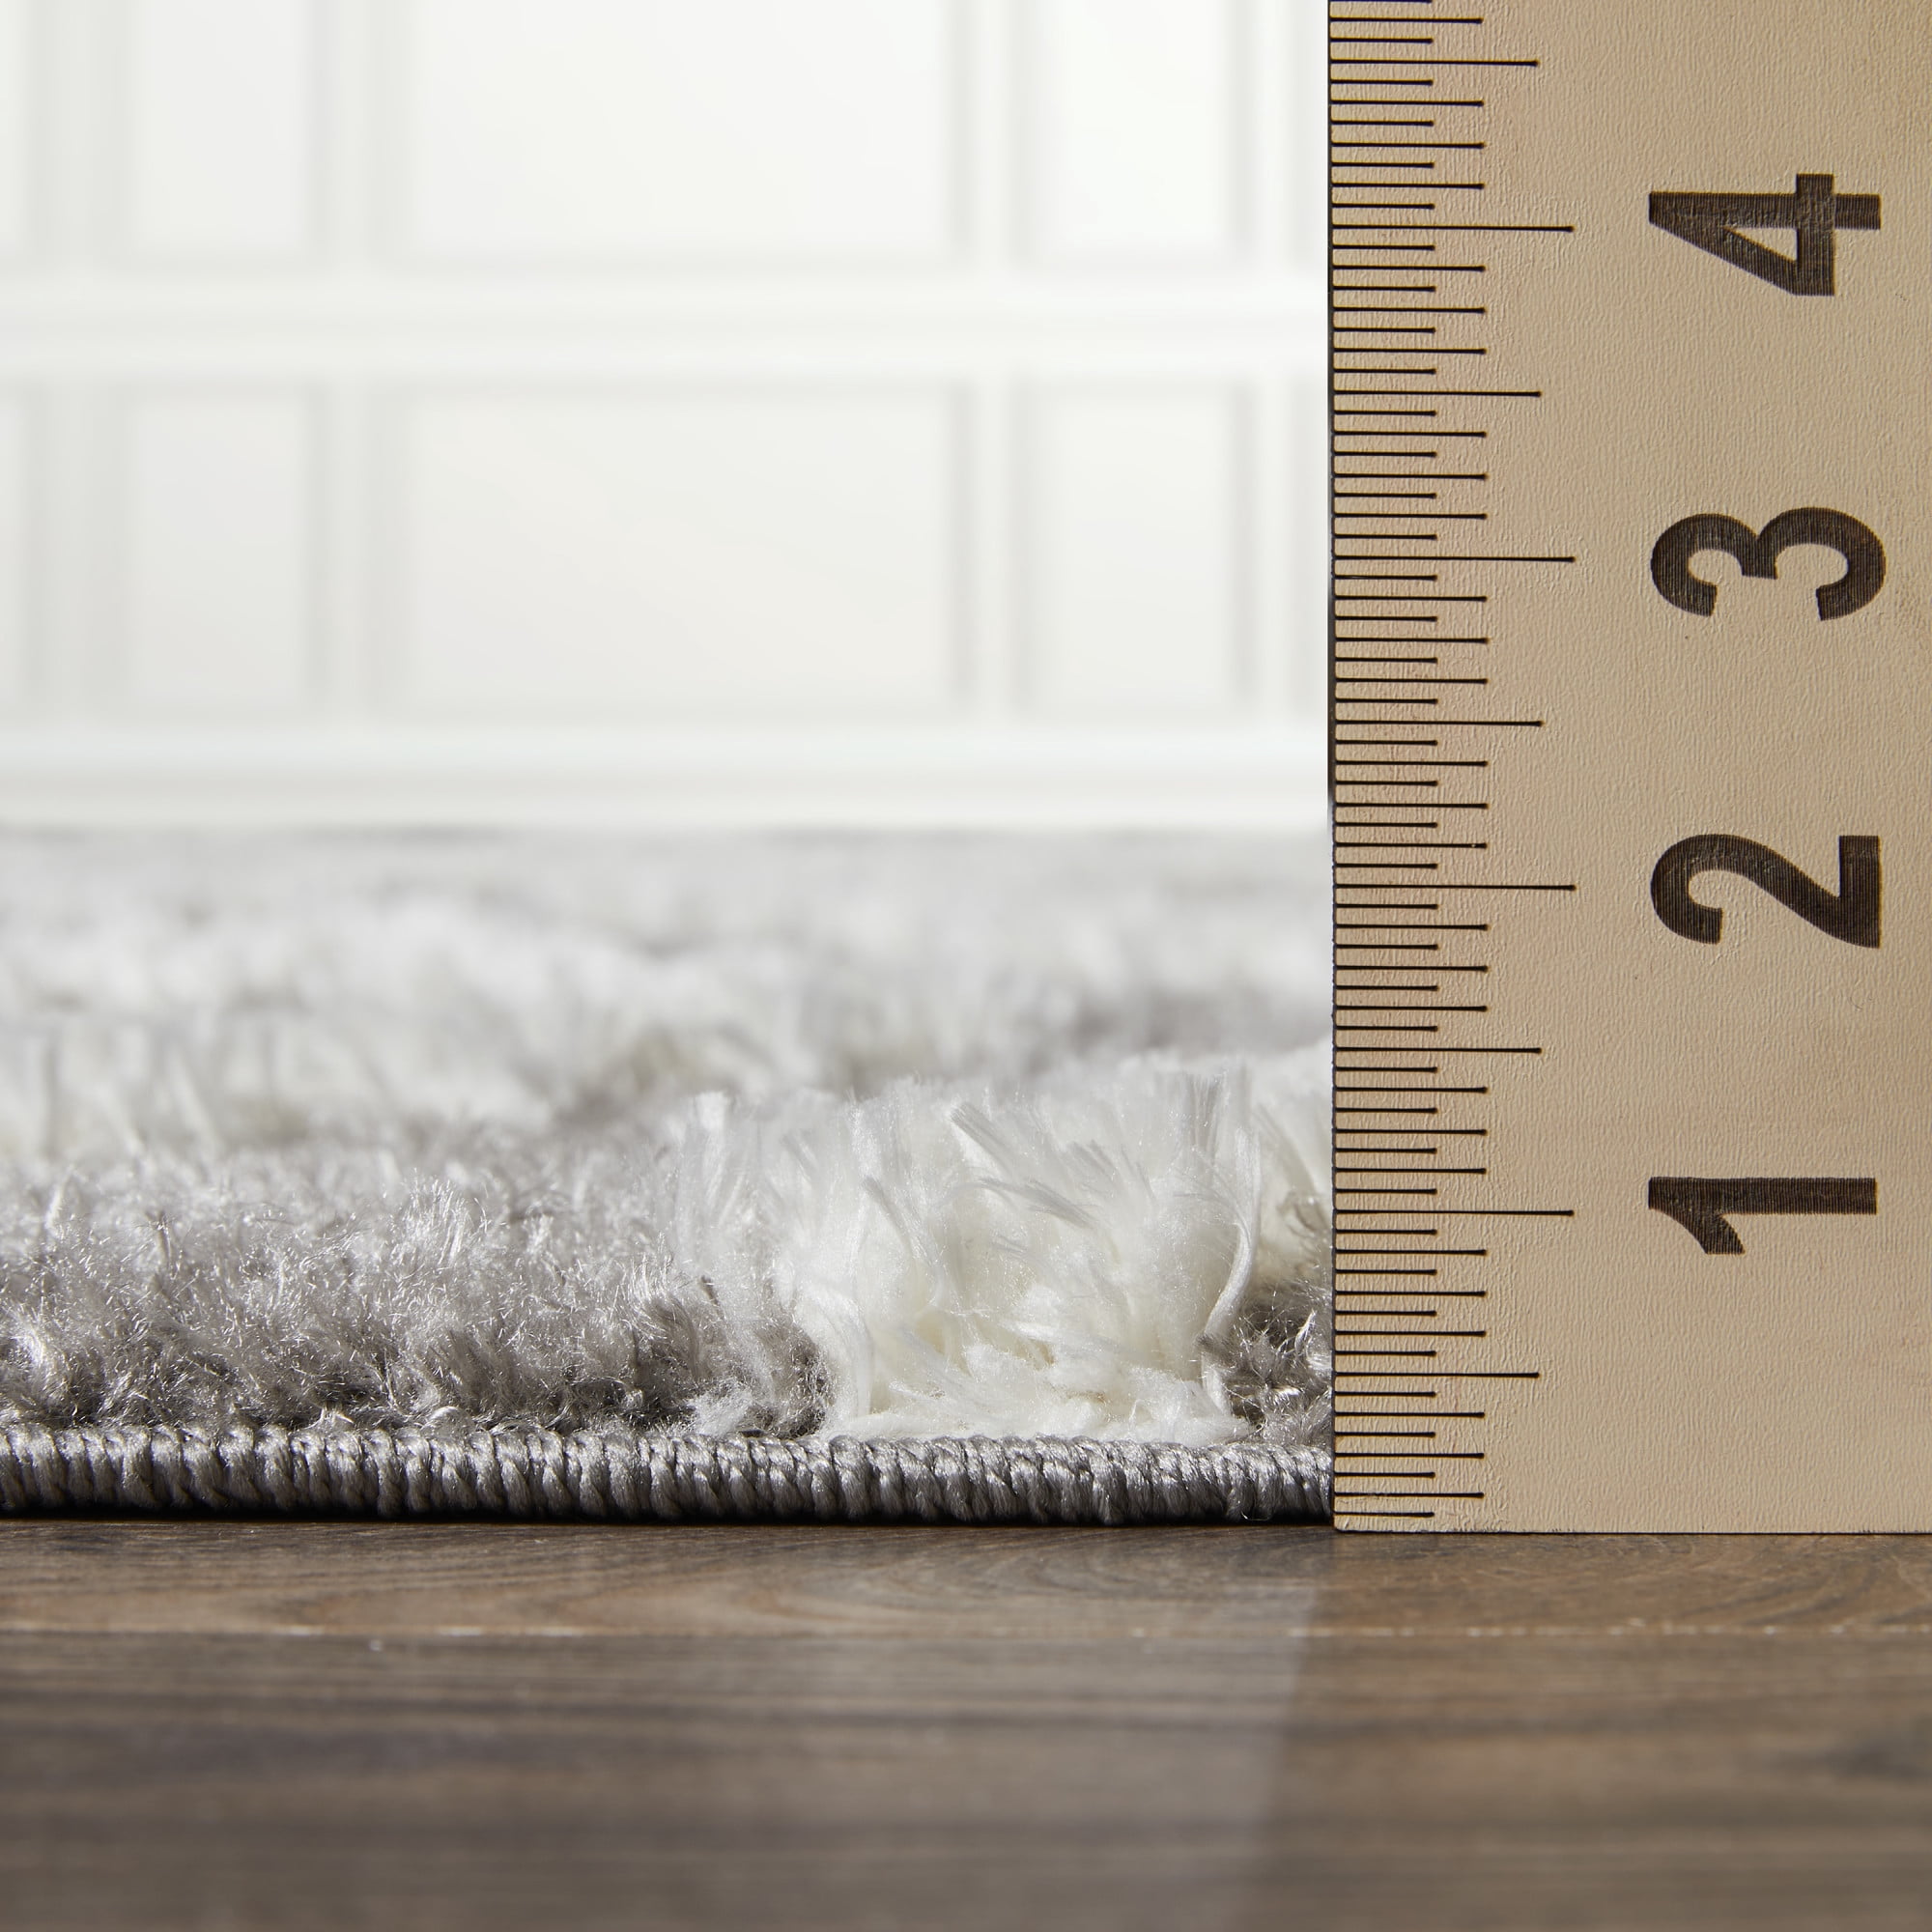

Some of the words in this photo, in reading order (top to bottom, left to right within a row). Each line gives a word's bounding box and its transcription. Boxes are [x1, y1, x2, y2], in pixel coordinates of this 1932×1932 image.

[1649, 174, 1881, 296] 4
[1651, 507, 1886, 621] 3
[1651, 834, 1882, 949] 2
[1648, 1177, 1876, 1255] 1
